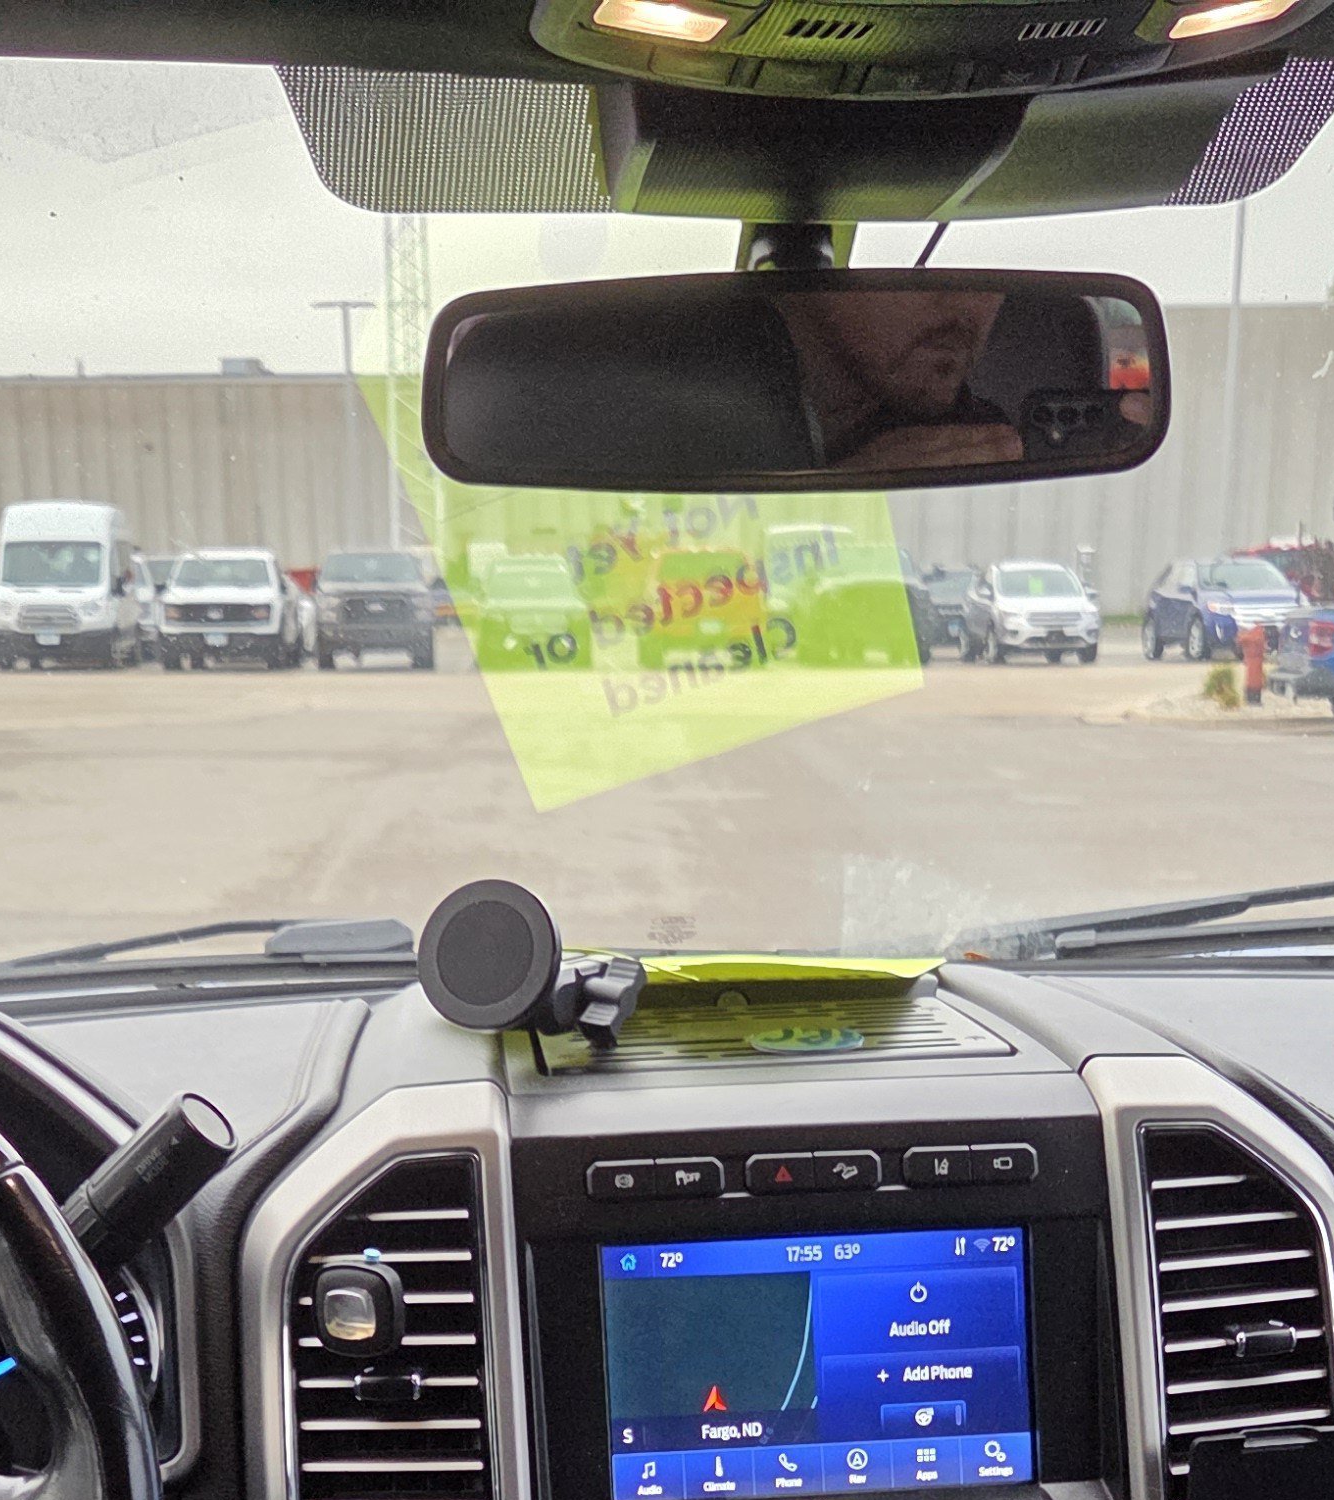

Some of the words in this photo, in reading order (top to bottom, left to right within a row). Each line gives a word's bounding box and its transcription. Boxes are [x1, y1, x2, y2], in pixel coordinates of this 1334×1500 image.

[785, 1245, 823, 1262] 17:55
[889, 1319, 927, 1338] Audio
[928, 1318, 951, 1336] Off
[902, 1366, 930, 1381] Add
[930, 1363, 973, 1381] Phone
[622, 1428, 634, 1445] S
[701, 1423, 741, 1442] Fargo,
[742, 1422, 763, 1438] ND
[848, 1472, 867, 1485] Nav
[915, 1469, 939, 1483] Apps
[978, 1463, 1014, 1479] Settings
[637, 1482, 663, 1497] Audio
[703, 1479, 736, 1493] Climate
[775, 1475, 803, 1489] Phone
